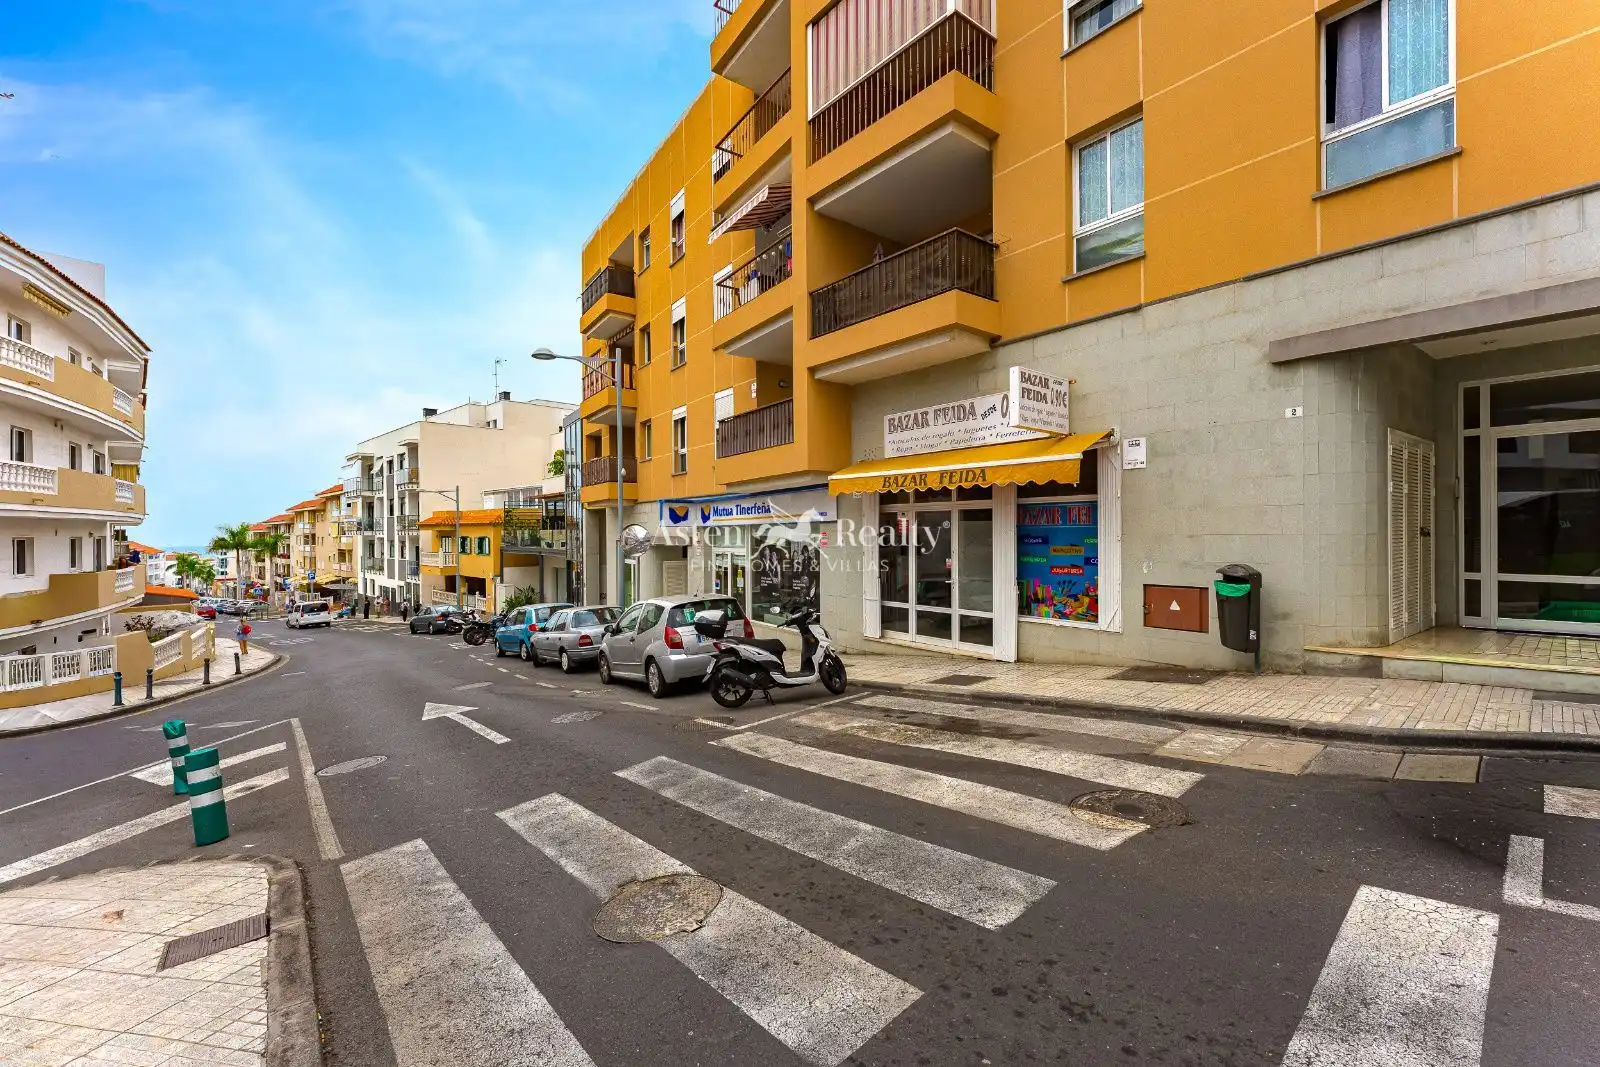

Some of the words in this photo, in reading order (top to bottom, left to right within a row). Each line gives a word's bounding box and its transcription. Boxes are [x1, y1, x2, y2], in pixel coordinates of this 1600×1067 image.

[1020, 371, 1050, 390] BAZAR
[1021, 387, 1049, 405] FEIDA
[888, 410, 932, 435] BAZAR
[933, 401, 978, 427] FEIDA
[980, 403, 998, 421] DESDE
[1291, 408, 1297, 417] 2
[882, 472, 928, 489] BAZAR
[938, 468, 988, 486] FEIDA
[712, 506, 733, 517] Mutua
[735, 502, 771, 516] Tinerfeña
